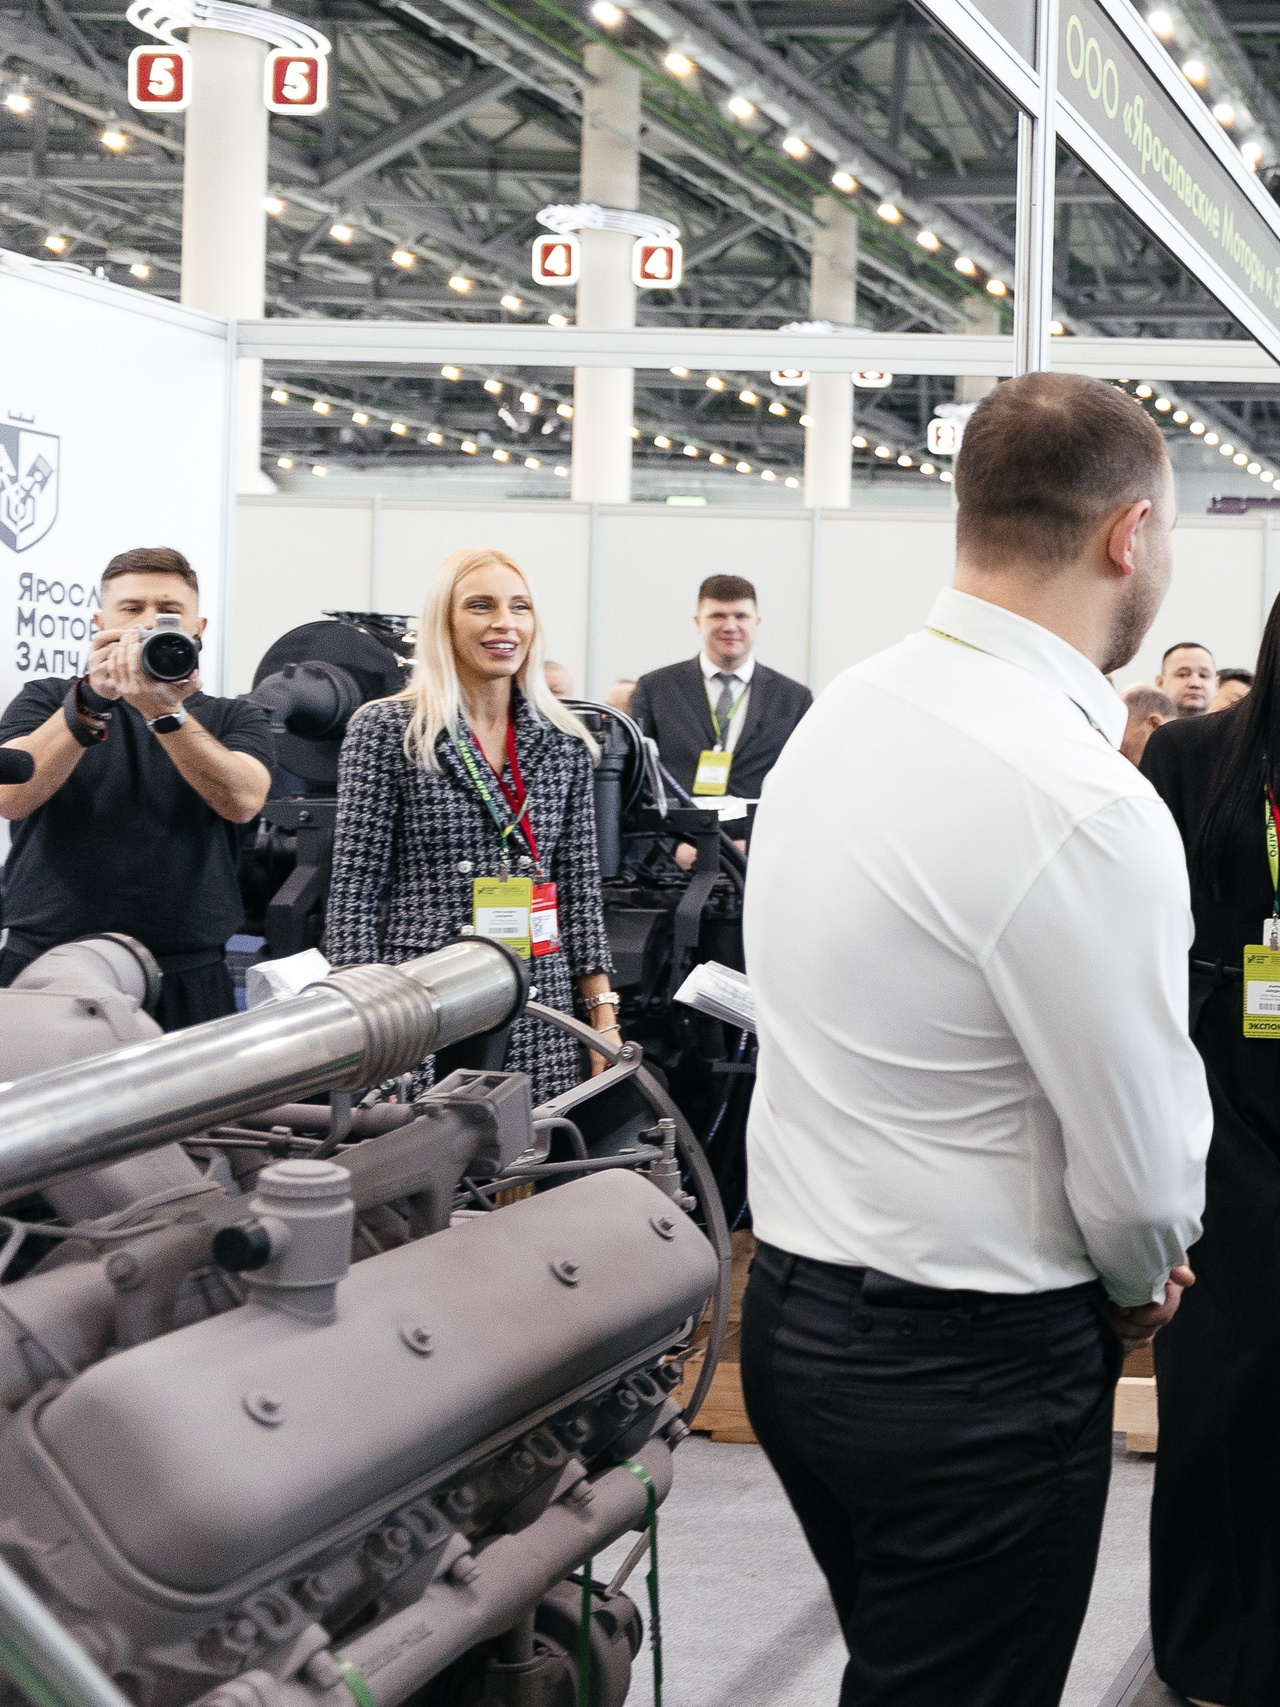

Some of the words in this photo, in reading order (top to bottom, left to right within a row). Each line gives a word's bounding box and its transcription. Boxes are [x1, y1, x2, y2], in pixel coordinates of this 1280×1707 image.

[147, 57, 175, 96] 5
[281, 61, 310, 100] 5
[1066, 14, 1119, 119] ООО
[1123, 94, 1220, 239] «Ярославские
[544, 245, 567, 276] 4
[644, 248, 669, 279] 4
[1268, 832, 1278, 858] АГРО
